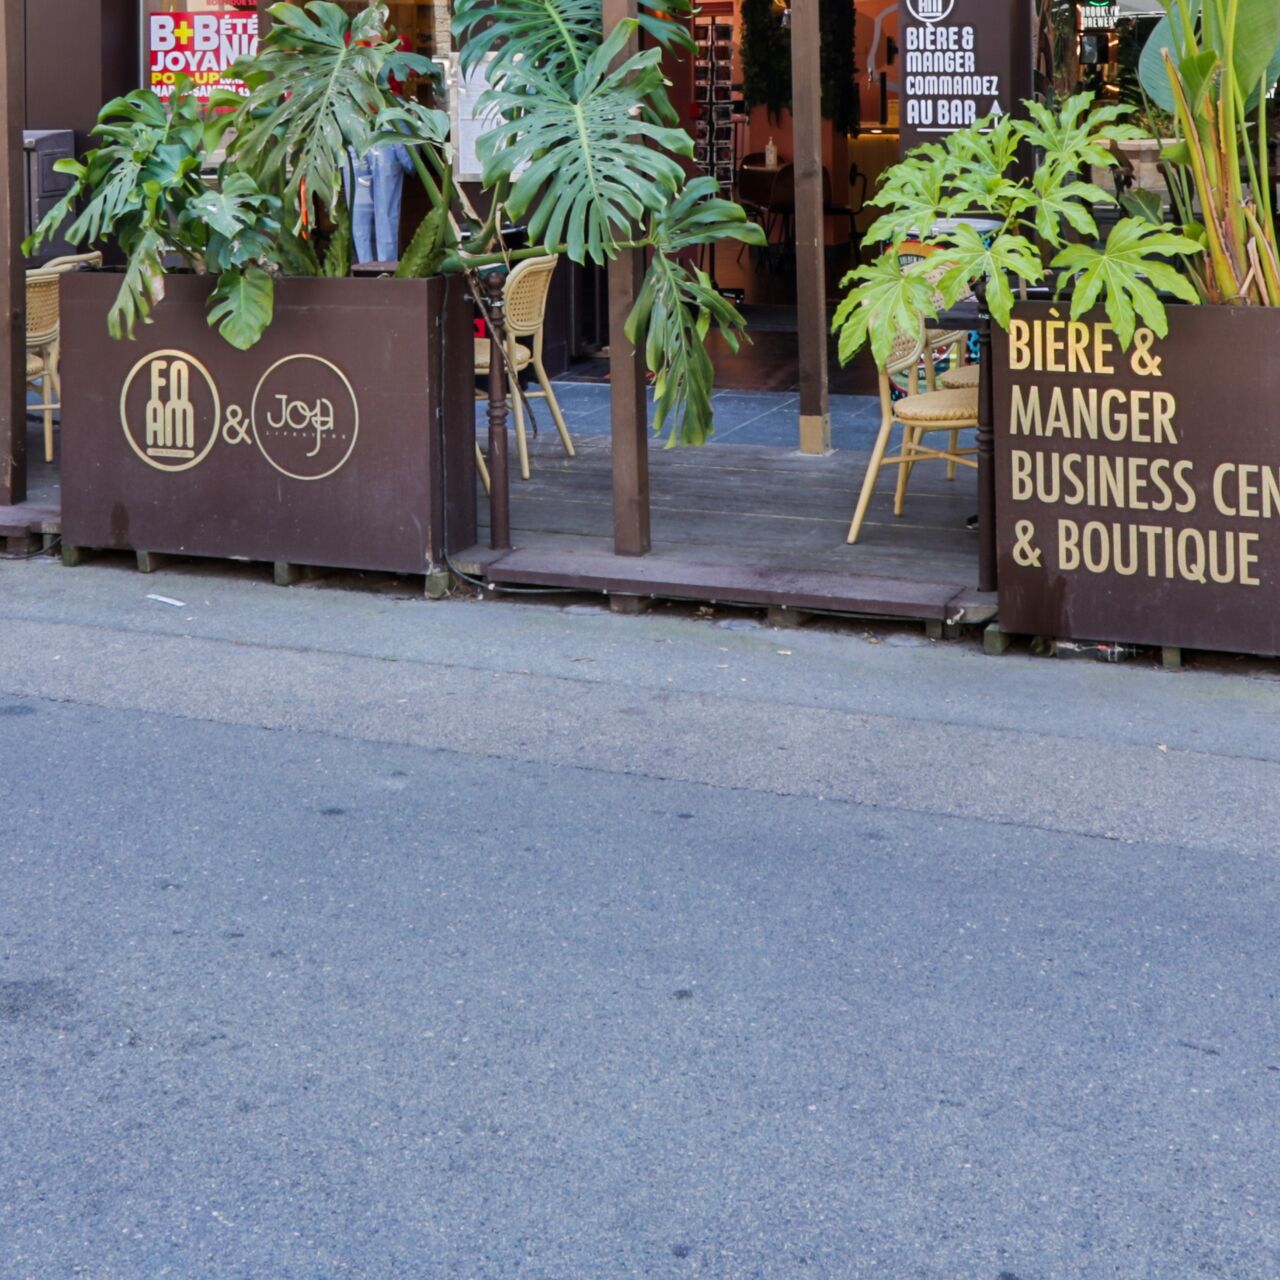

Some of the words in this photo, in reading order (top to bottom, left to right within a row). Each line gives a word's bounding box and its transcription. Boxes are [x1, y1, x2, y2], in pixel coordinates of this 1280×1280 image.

[151, 15, 219, 51] B+B
[220, 14, 258, 35] ÉTÉ
[906, 22, 959, 50] BIÈRE
[962, 26, 974, 50] &
[151, 51, 219, 72] JOYA
[151, 71, 220, 84] PO-UP
[906, 51, 975, 73] MANGER
[906, 76, 999, 96] COMMANDEZ
[907, 99, 933, 125] AU
[937, 99, 976, 125] BAR
[1008, 307, 1115, 375] BIÈRE
[1130, 327, 1163, 377] &
[222, 404, 252, 445] &
[1009, 384, 1178, 445] MANGER
[1011, 449, 1197, 514] BUSINESS
[1012, 519, 1042, 568] &
[1057, 518, 1261, 586] BOUTIQUE
